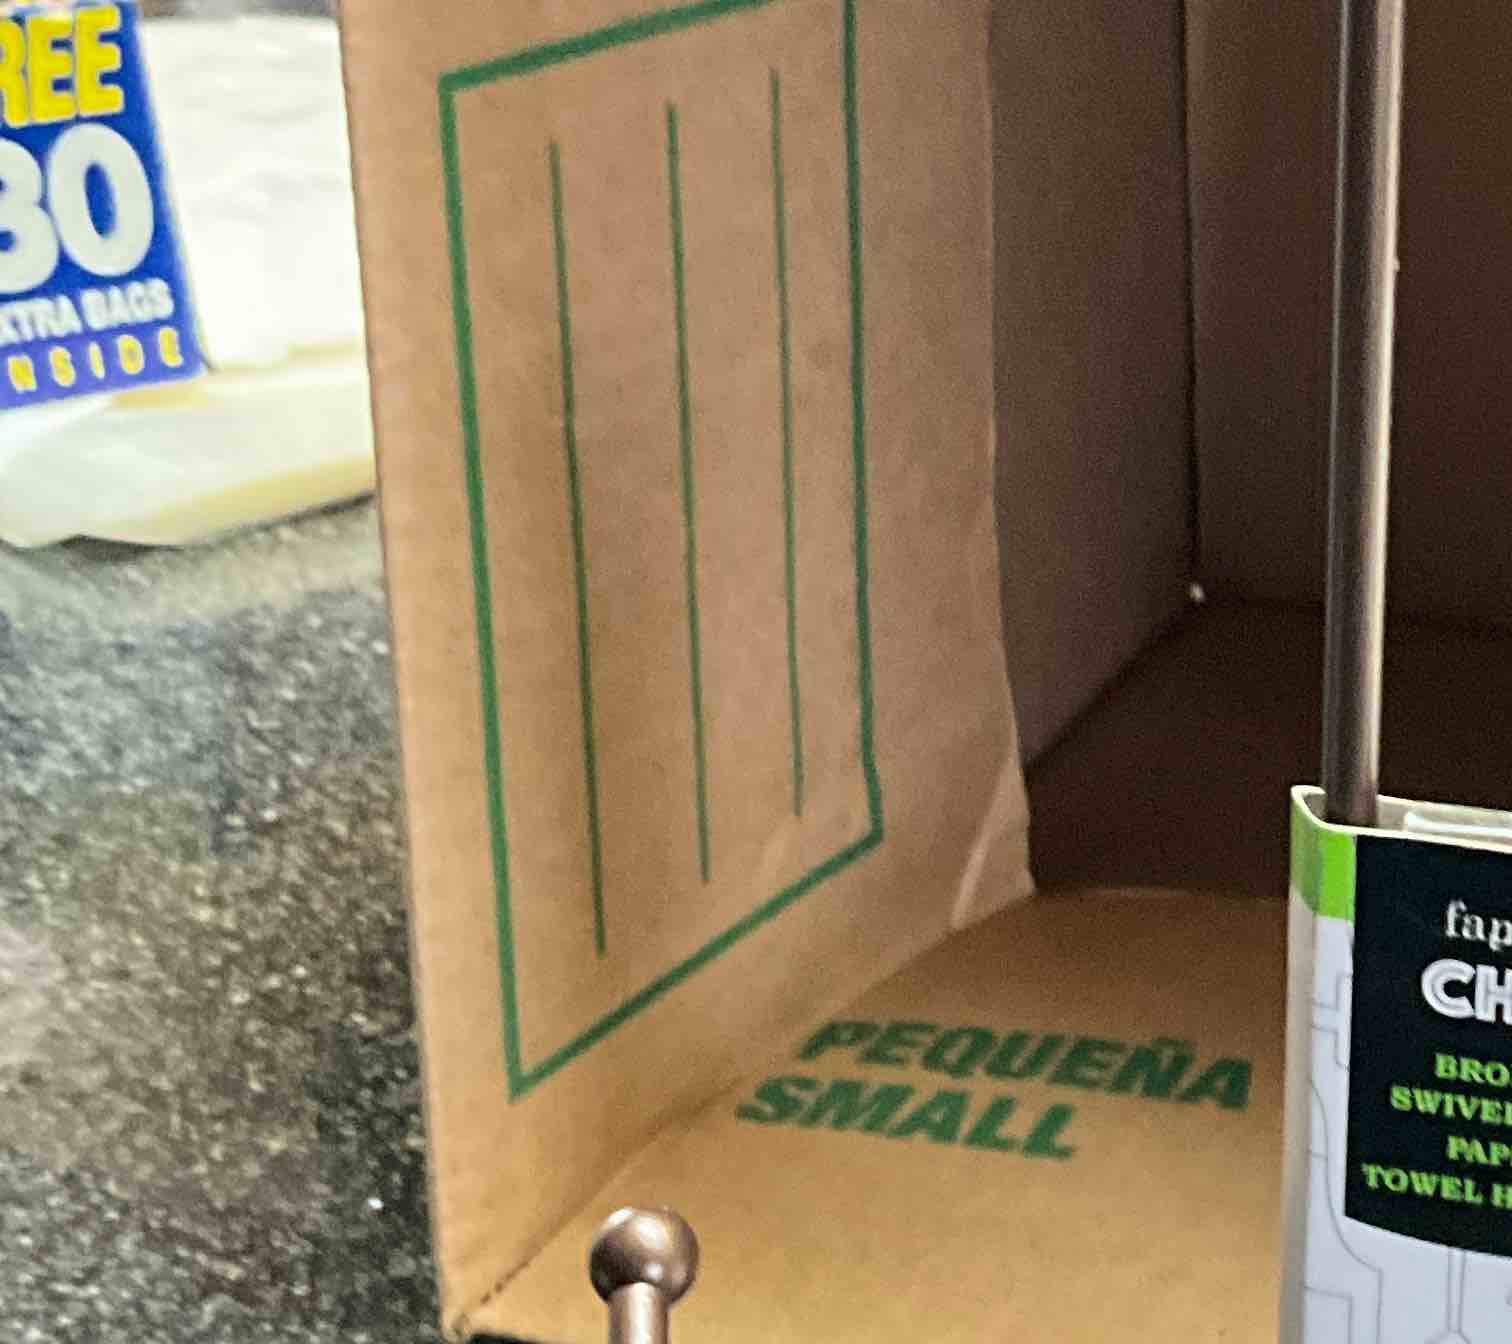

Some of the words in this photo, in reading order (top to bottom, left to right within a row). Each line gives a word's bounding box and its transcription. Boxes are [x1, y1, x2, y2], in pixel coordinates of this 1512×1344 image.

[81, 277, 175, 330] BAGS
[799, 1020, 1255, 1112] PEQUEÑA
[735, 1075, 1077, 1162] SMALL
[1361, 1163, 1484, 1205] TOWEL
